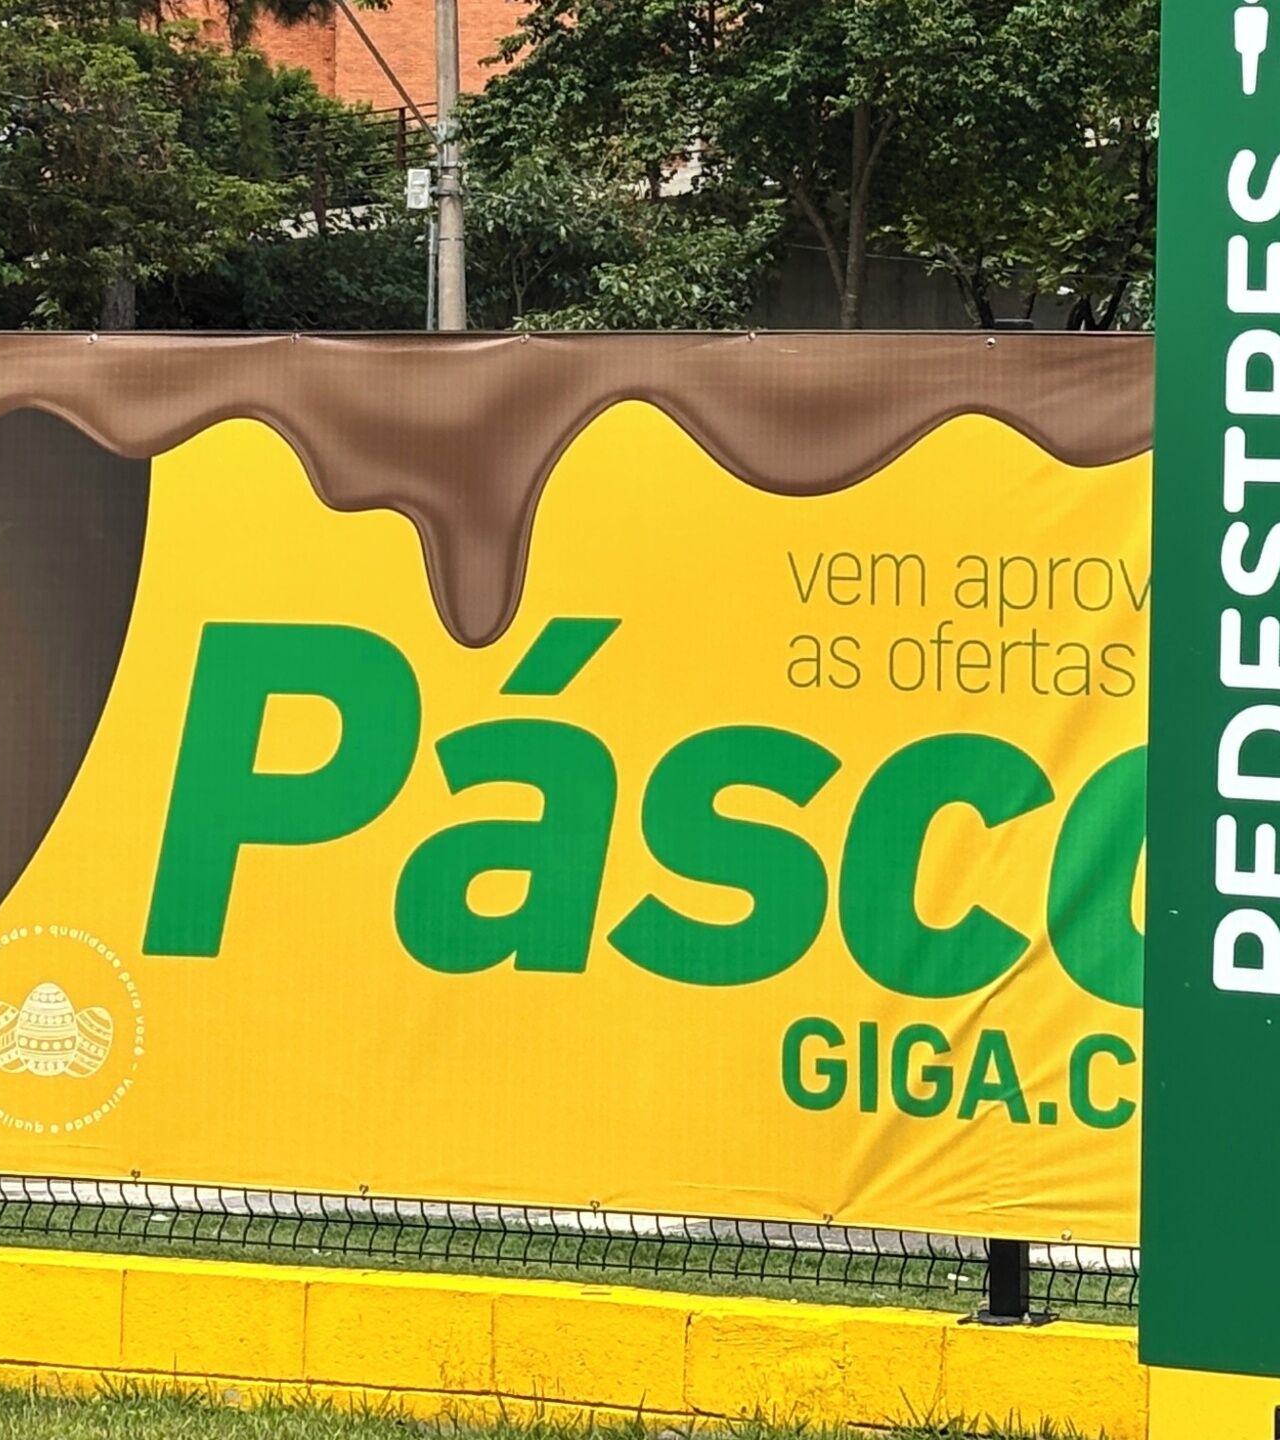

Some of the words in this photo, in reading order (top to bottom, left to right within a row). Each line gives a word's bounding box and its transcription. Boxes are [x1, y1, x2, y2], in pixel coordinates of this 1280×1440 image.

[787, 551, 926, 607] vem
[787, 634, 862, 690] as
[889, 620, 1136, 698] ofertas
